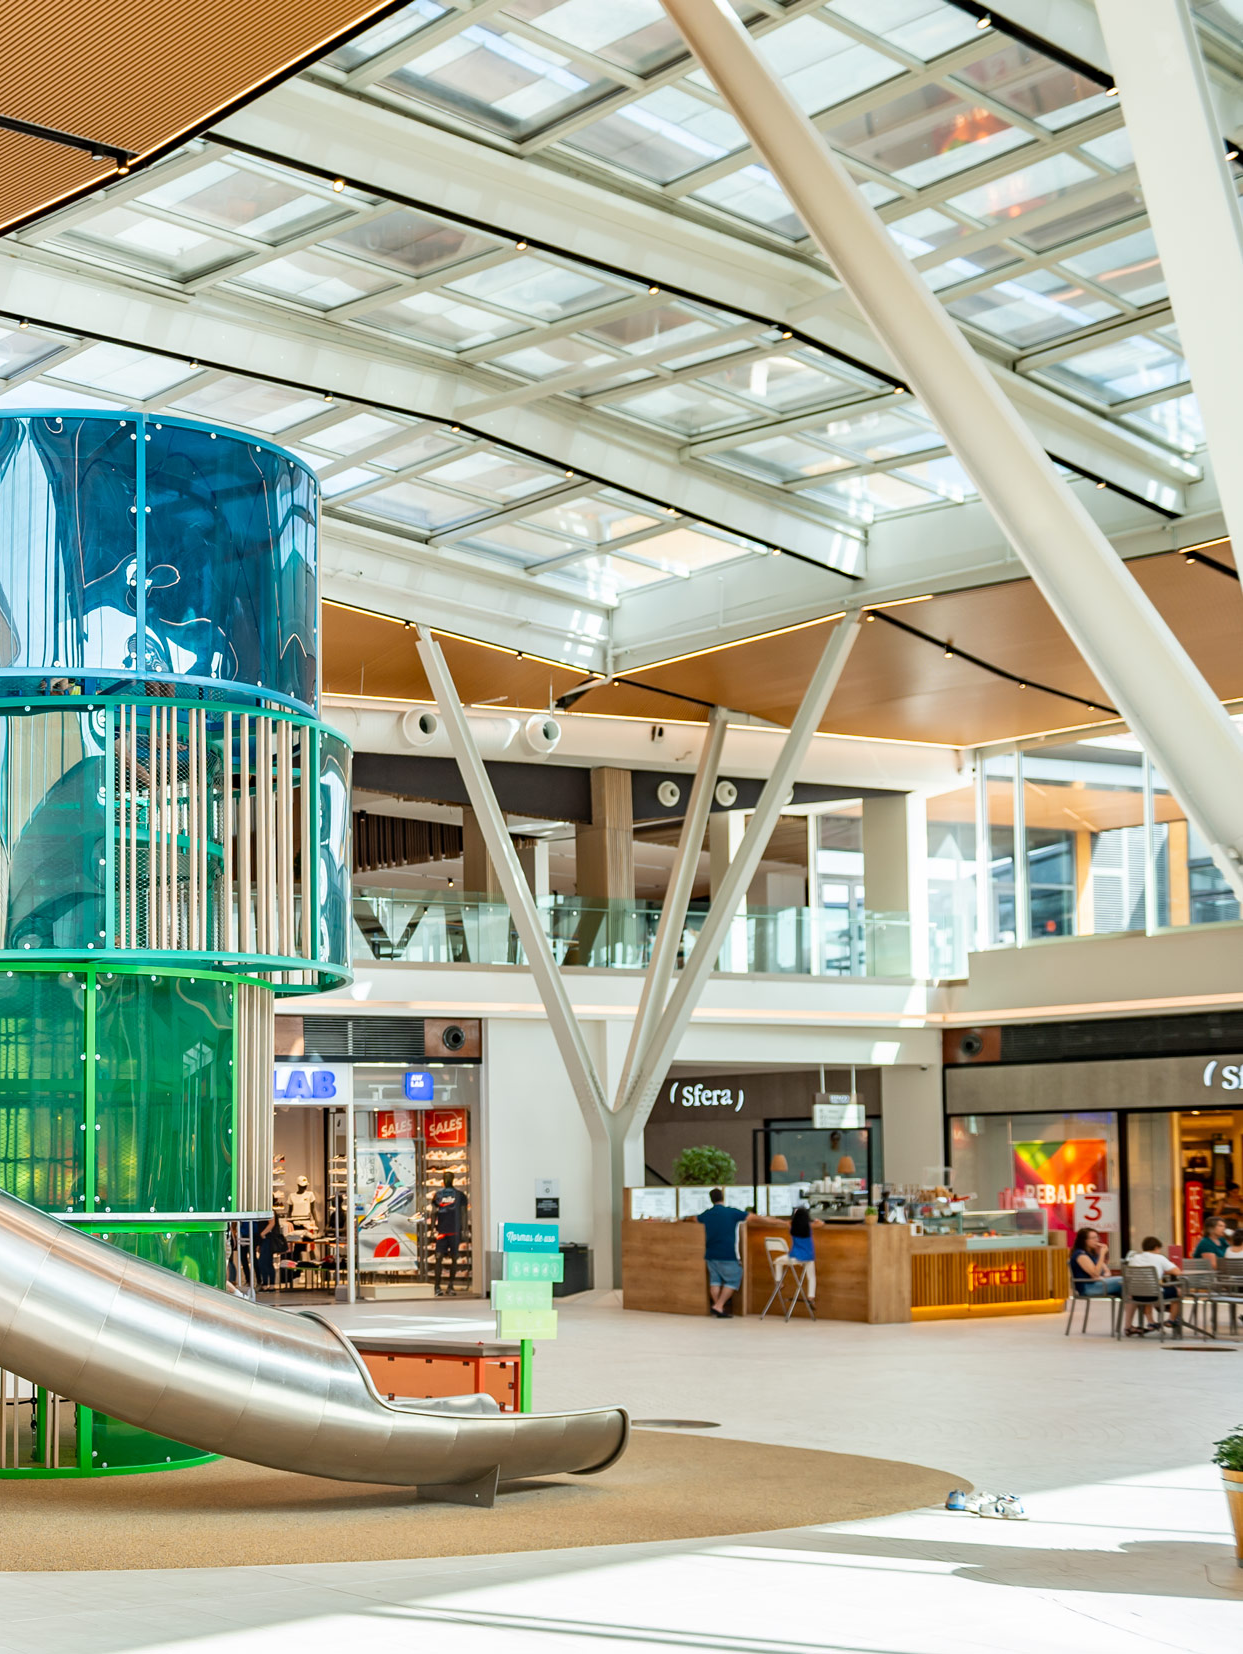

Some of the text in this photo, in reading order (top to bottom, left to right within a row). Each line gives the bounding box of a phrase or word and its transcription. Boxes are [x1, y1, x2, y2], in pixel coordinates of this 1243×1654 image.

[381, 1119, 413, 1138] SALES
[429, 1117, 463, 1137] SALES
[1084, 1196, 1103, 1221] 3
[506, 1231, 556, 1243] Normas de uso
